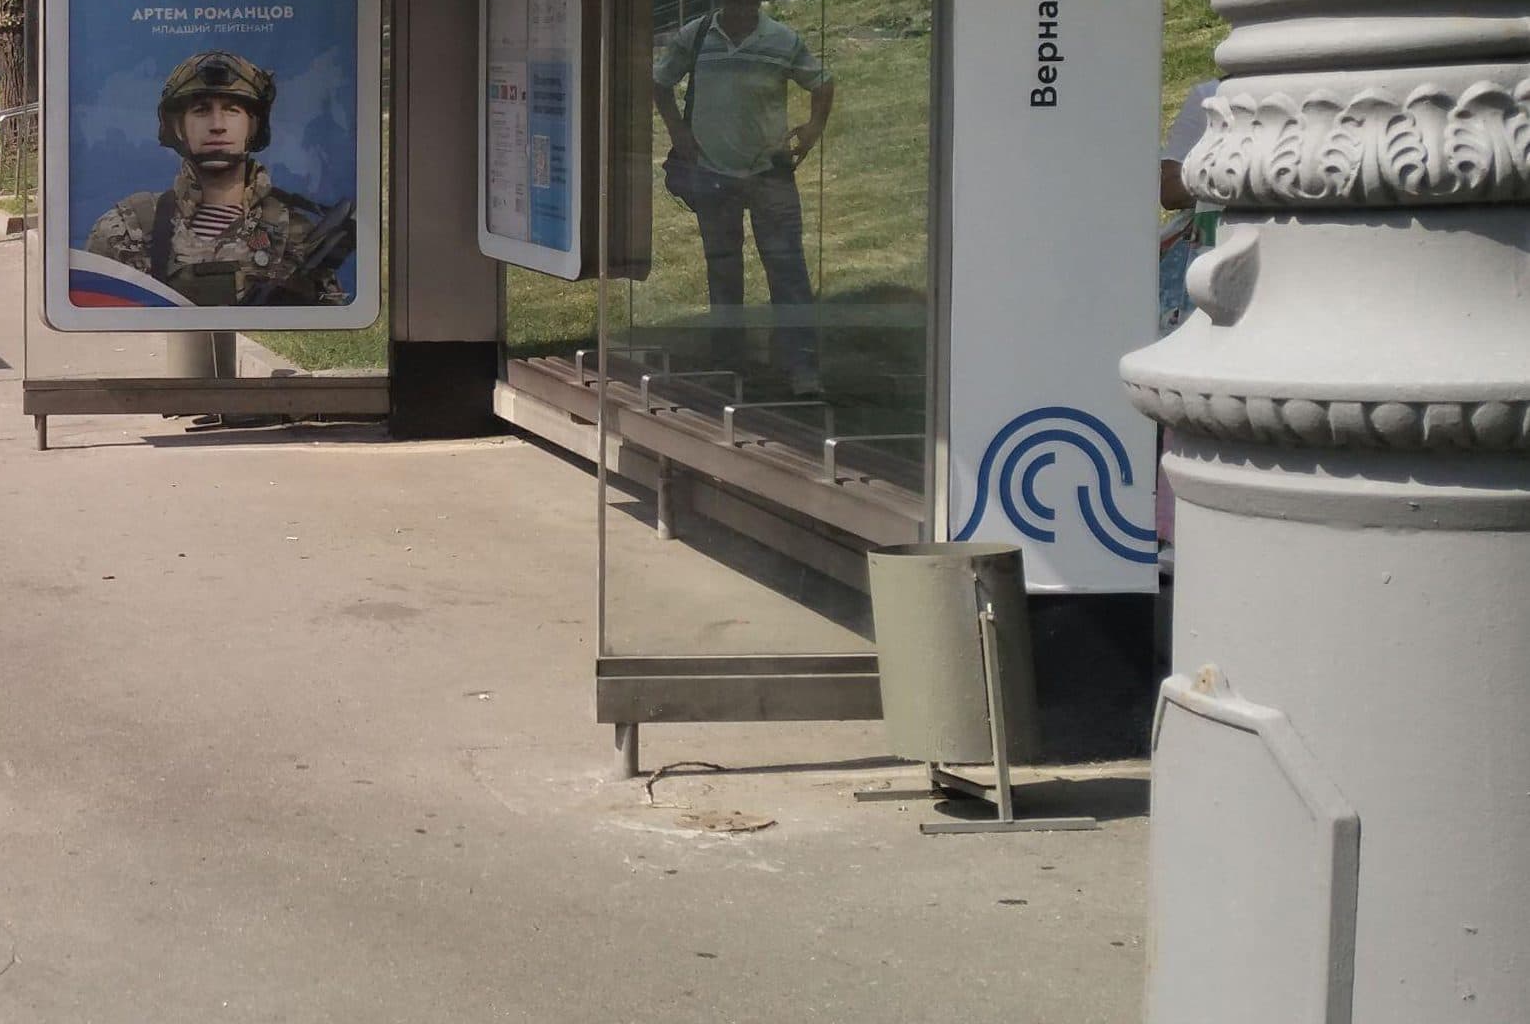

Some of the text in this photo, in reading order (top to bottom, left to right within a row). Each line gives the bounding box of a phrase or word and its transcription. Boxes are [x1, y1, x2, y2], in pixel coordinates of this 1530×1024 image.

[131, 5, 295, 21] АРТЕМ РОМАНЦОВ
[151, 23, 274, 34] МЛАДШИЙ ЛЕЙТЕНАНТ
